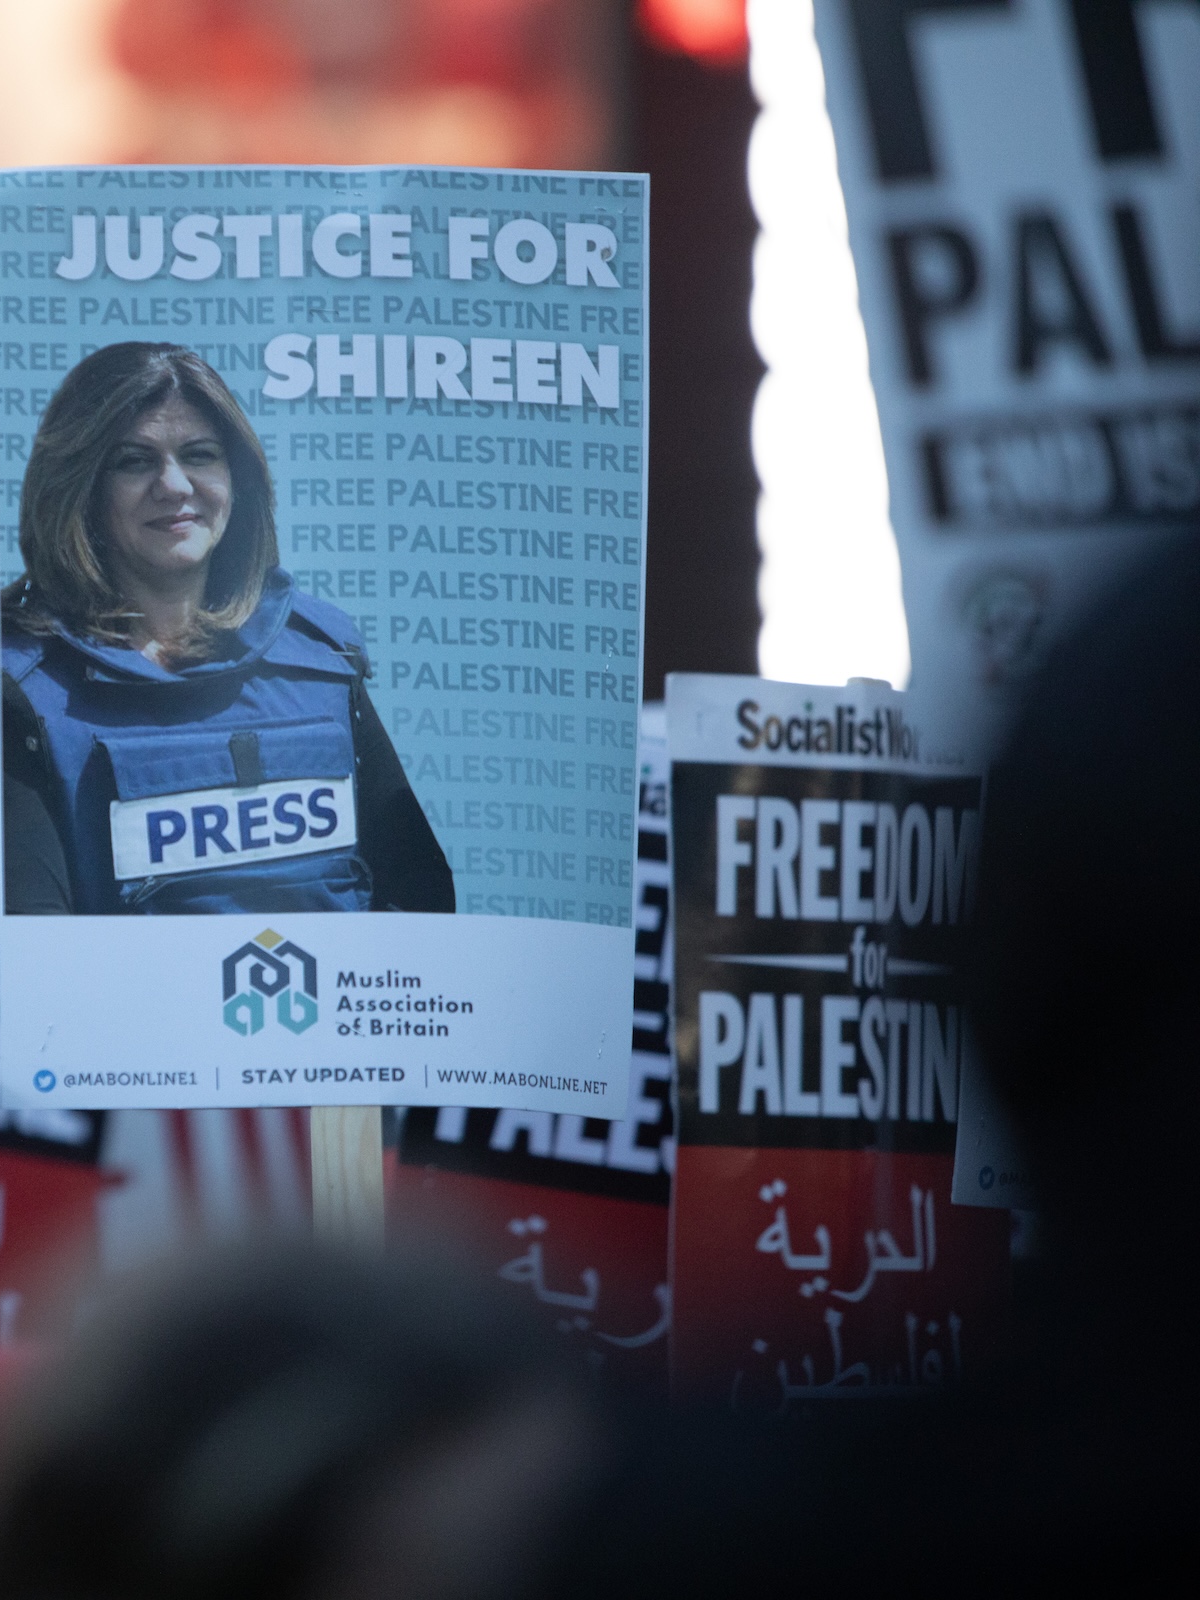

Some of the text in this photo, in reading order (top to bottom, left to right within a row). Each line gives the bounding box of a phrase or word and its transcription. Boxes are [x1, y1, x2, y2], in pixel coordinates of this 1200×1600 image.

[56, 213, 413, 280] JUSTICE
[449, 216, 621, 289] FOR
[79, 297, 274, 326] PALESTINE
[288, 296, 370, 325] FREE
[384, 296, 568, 330] PALESTINE
[263, 333, 620, 410] SHIREEN
[290, 432, 373, 461] FREE
[386, 432, 571, 469] PALESTINE
[291, 478, 374, 507] FREE
[387, 478, 573, 515] PALESTINE
[291, 523, 376, 552] FREE
[388, 523, 573, 560] PALESTINE
[389, 570, 573, 607] PALESTINE
[390, 615, 574, 652] PALESTINE
[391, 661, 574, 698] PALESTINE
[392, 707, 575, 744] PALESTINE
[147, 788, 338, 863] PRESS
[850, 927, 887, 988] for
[336, 970, 422, 989] Muslim
[336, 995, 474, 1015] Association
[337, 1018, 450, 1038] of Britain
[699, 991, 959, 1122] PALESTIN
[64, 1069, 198, 1088] @MABONLINE1
[241, 1066, 405, 1086] STAY UPDATED
[437, 1068, 609, 1097] WWW.MABONLINE.NET
[755, 1178, 937, 1302] الحرية
